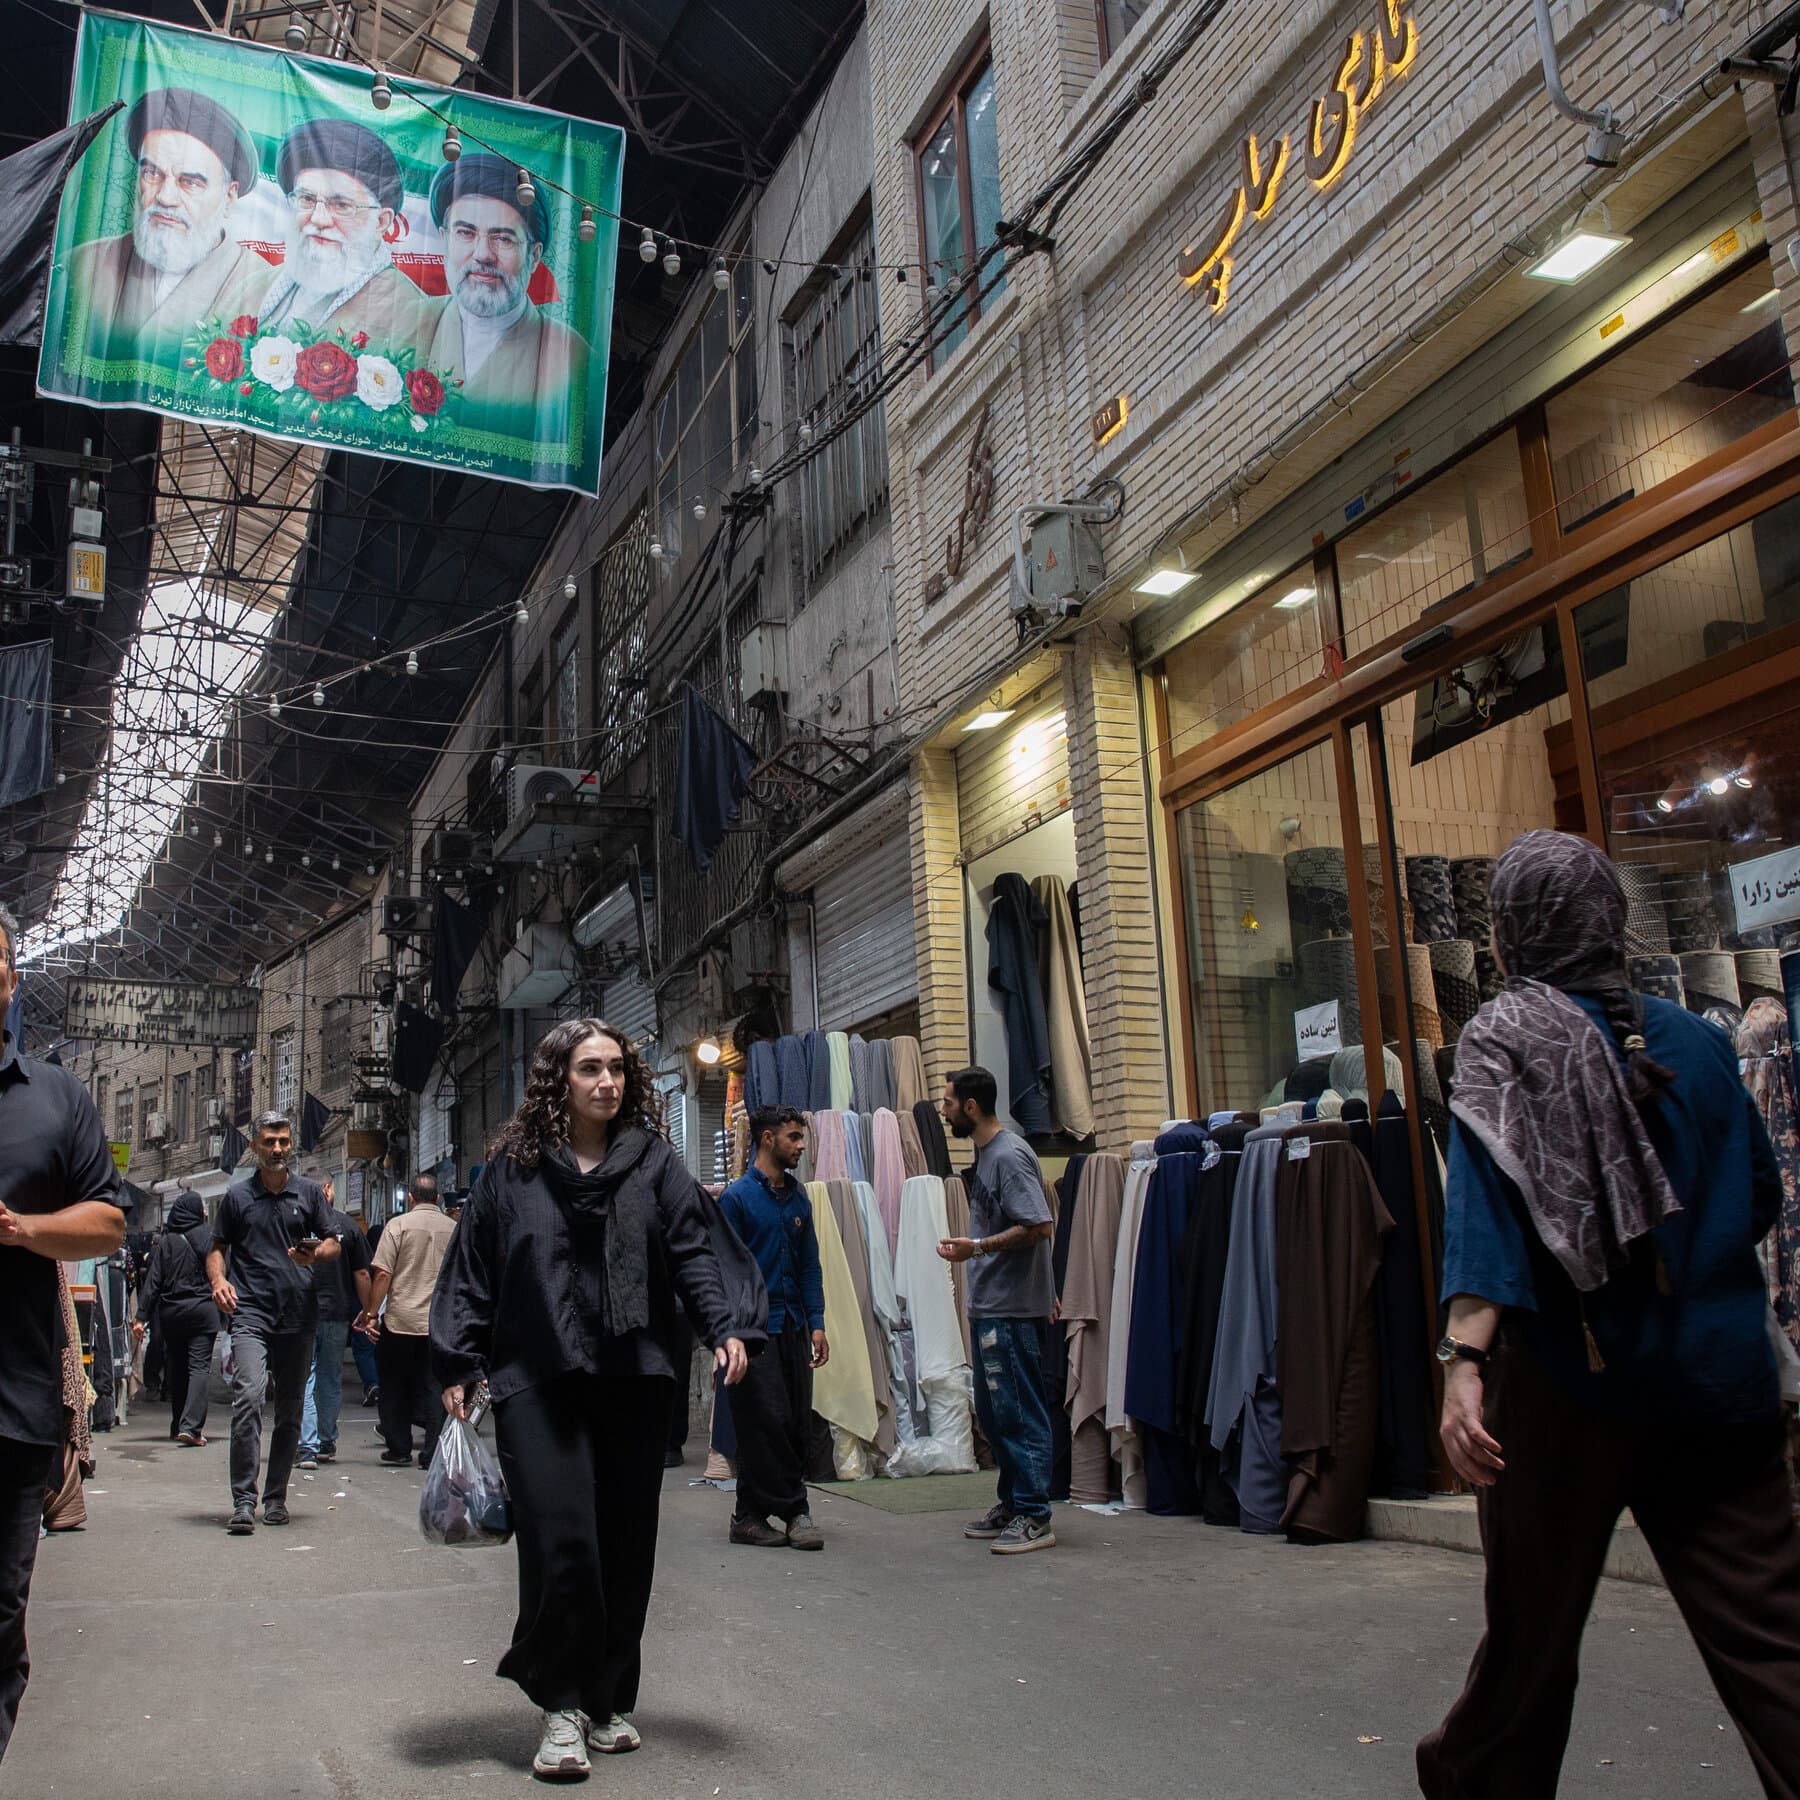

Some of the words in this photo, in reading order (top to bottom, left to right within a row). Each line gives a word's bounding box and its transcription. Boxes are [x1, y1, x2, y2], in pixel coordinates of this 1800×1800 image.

[149, 392, 173, 405] تهران
[173, 398, 193, 411] بازار
[247, 411, 275, 427] مسجد
[283, 423, 306, 433] غدیر
[308, 425, 343, 441] فرهنگی
[343, 432, 371, 446] شورای
[379, 440, 408, 452] قماش
[409, 444, 433, 456] صنف
[433, 449, 465, 463] اسلامی
[464, 457, 493, 470] انجمن
[1776, 868, 1800, 898] نین
[1742, 879, 1771, 907] زارا
[1300, 1023, 1319, 1039] ساده
[1321, 1016, 1337, 1038] لنین
